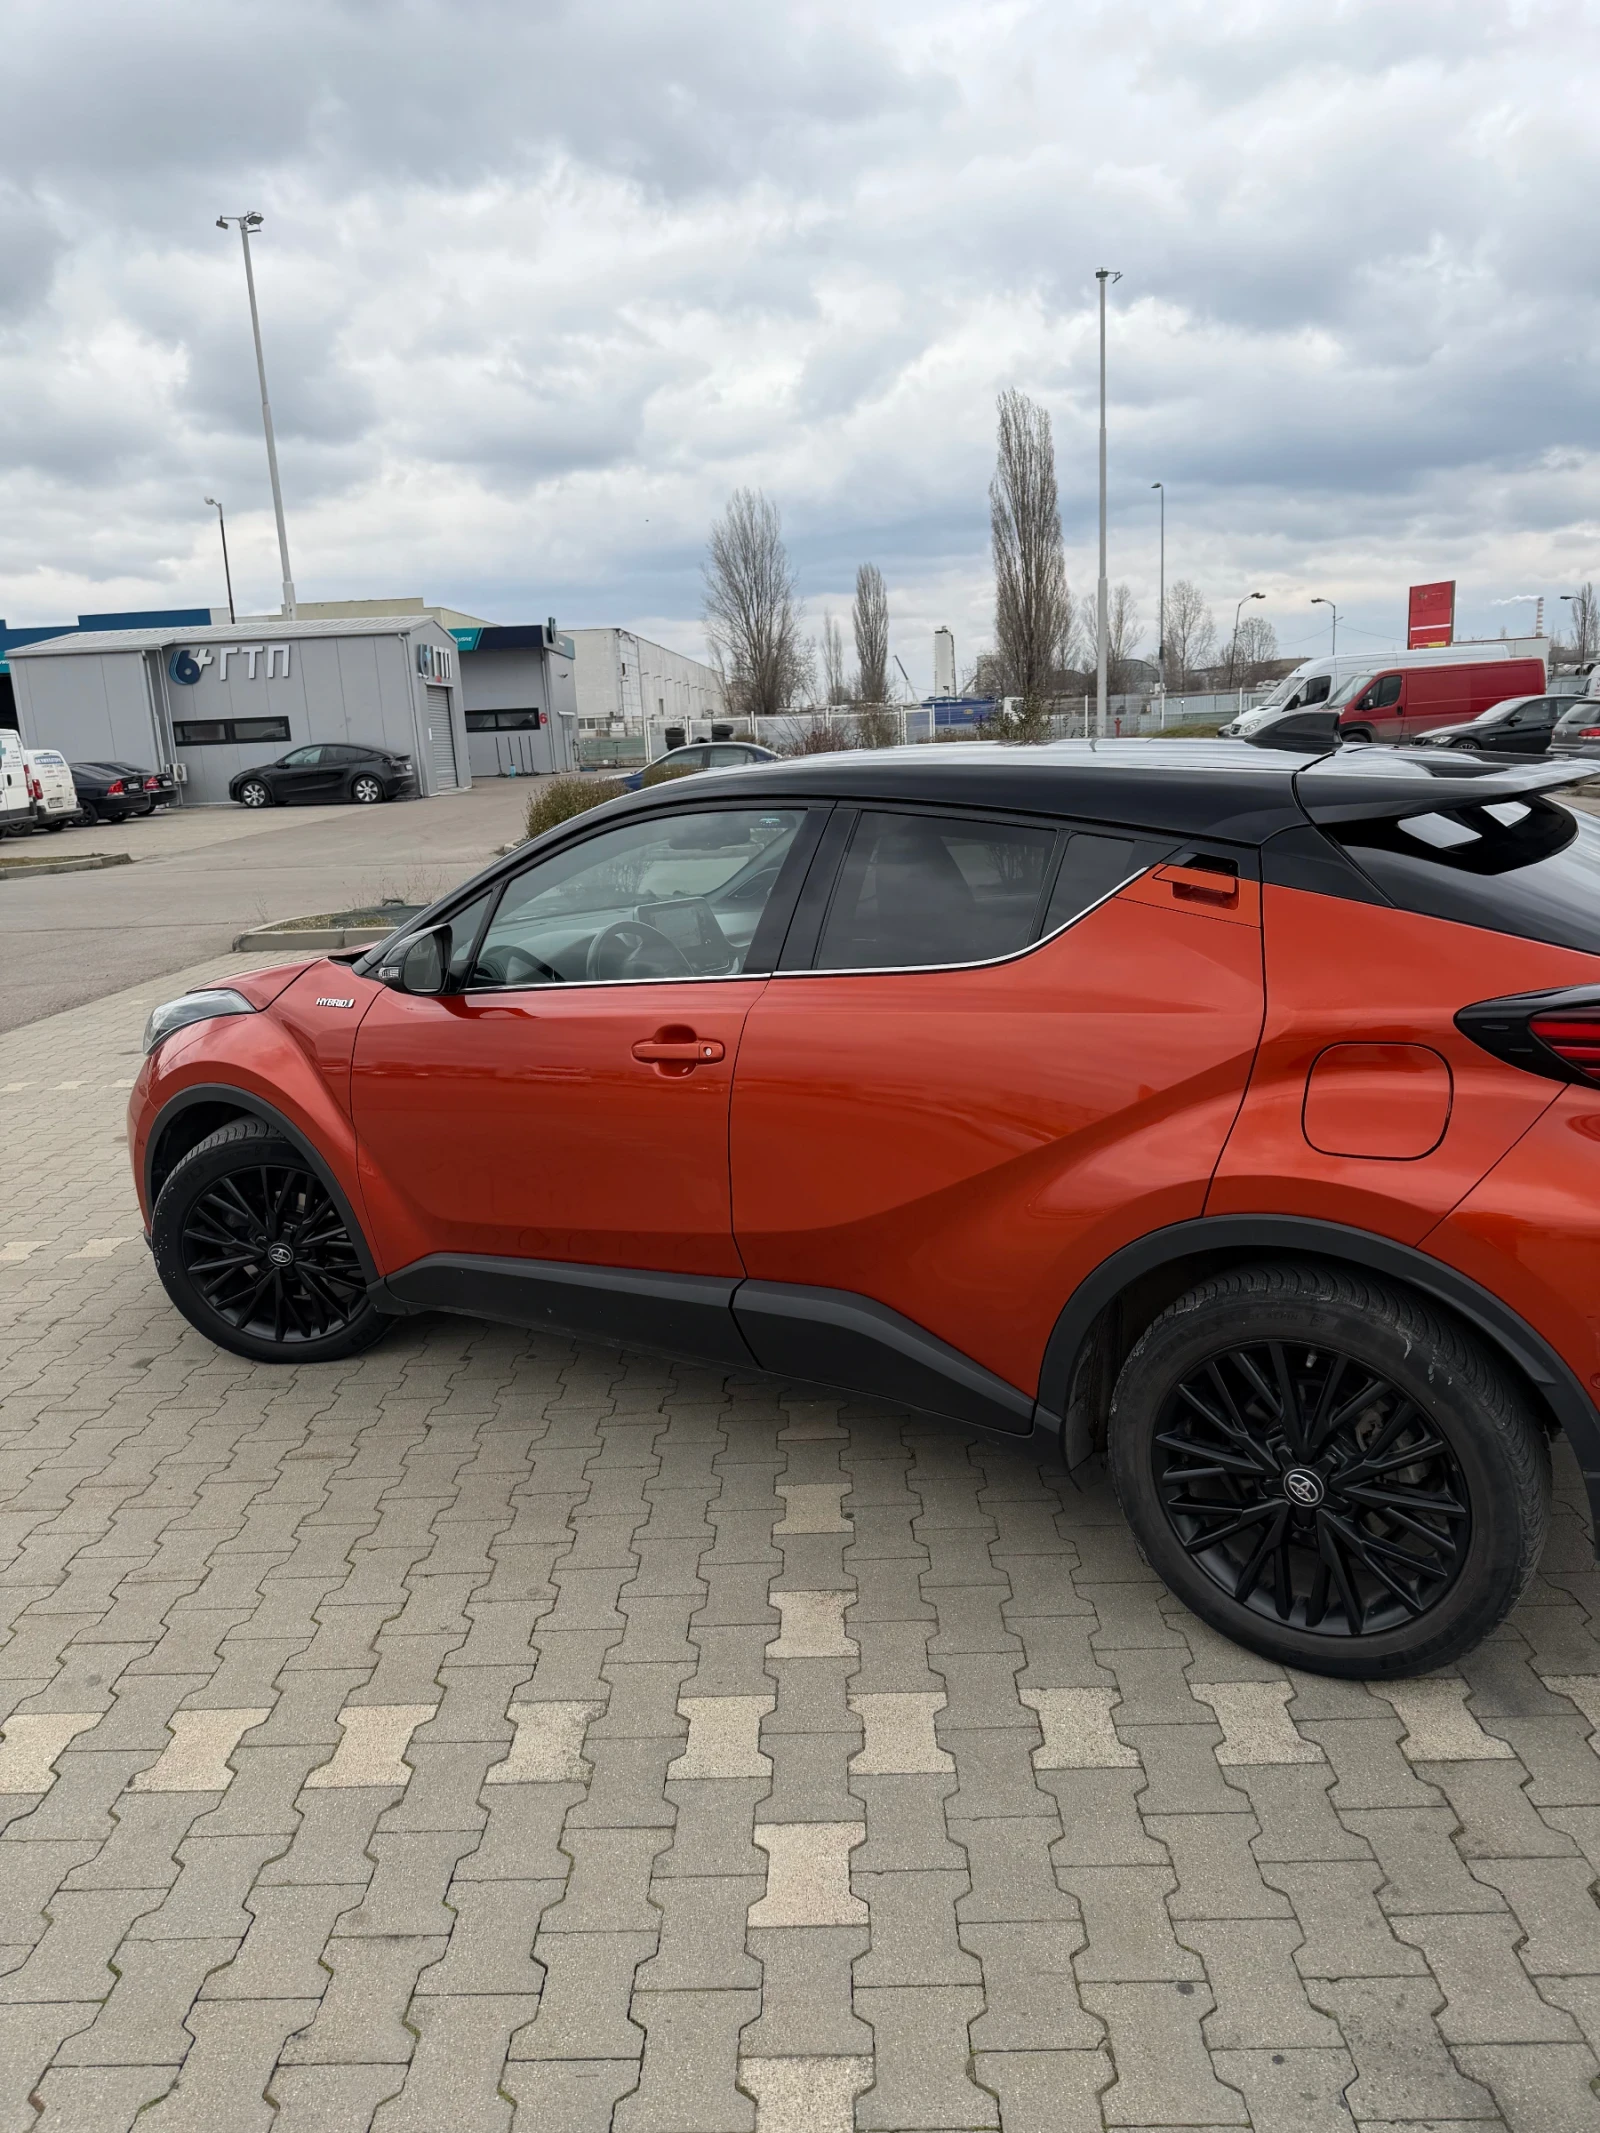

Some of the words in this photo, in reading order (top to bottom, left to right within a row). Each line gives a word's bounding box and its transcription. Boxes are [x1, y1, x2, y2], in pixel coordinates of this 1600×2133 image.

[219, 644, 291, 681] ГТП
[539, 712, 548, 724] 6
[316, 998, 347, 1007] HYBRID
